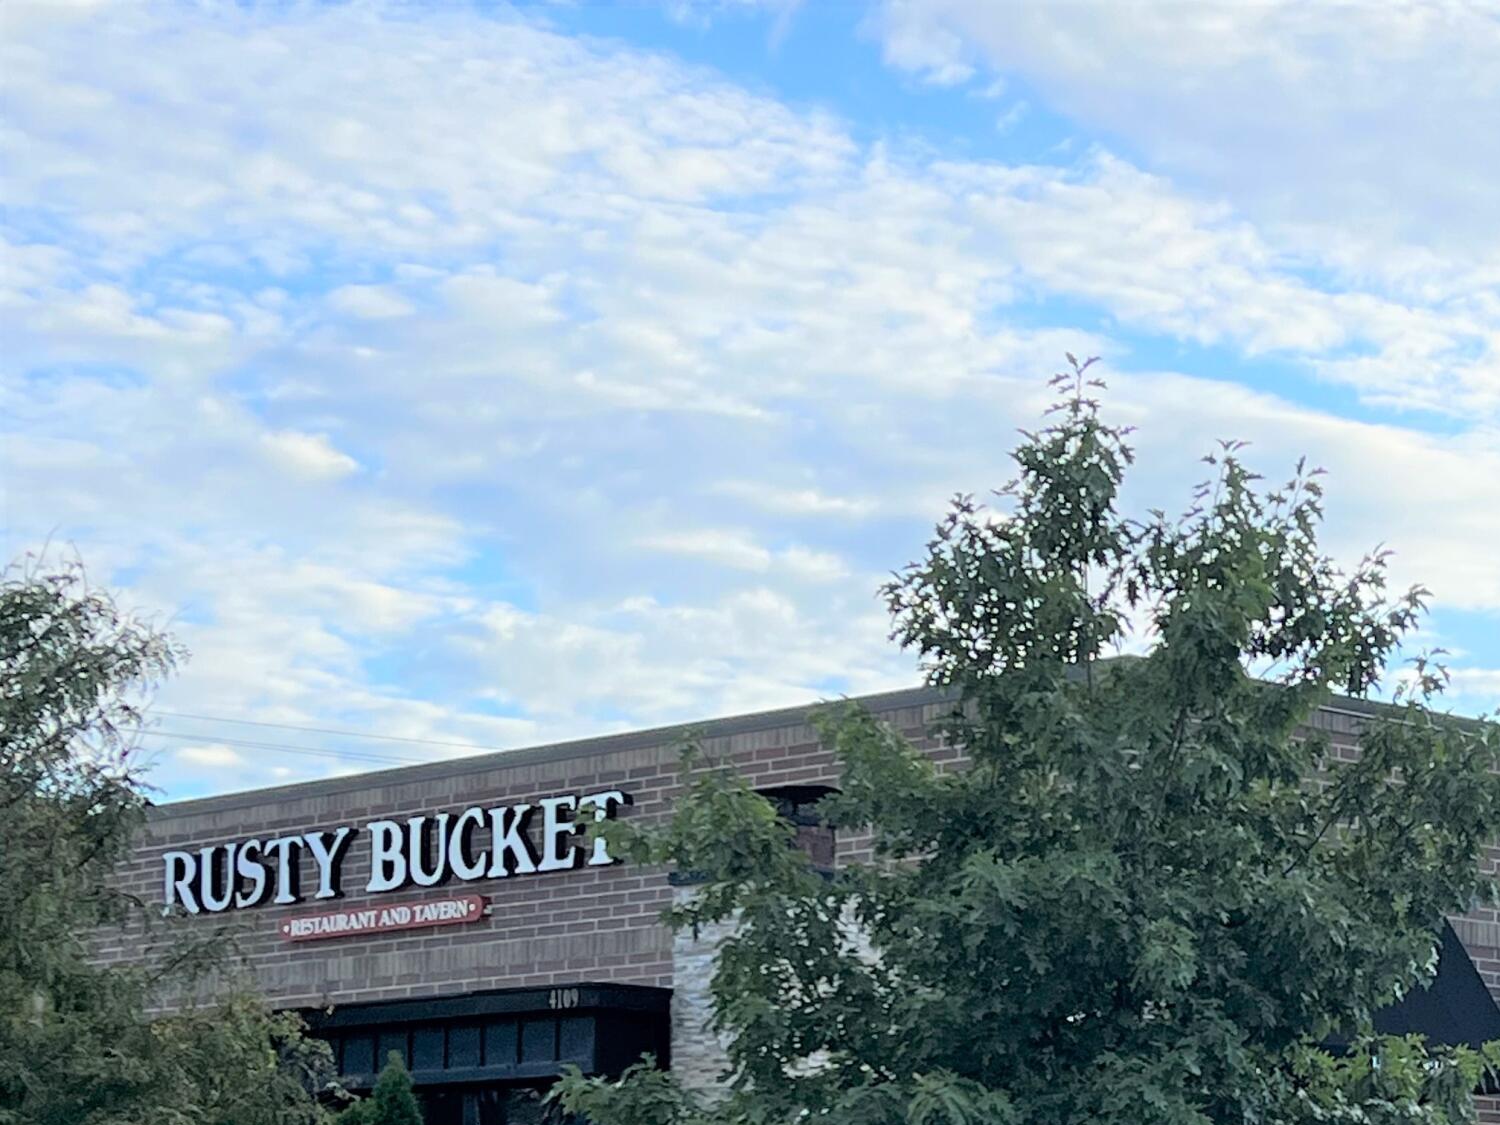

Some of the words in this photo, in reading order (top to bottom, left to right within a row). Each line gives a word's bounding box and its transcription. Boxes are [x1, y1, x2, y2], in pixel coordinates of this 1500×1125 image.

[162, 827, 353, 915] RUSTY
[365, 791, 625, 893] BUCKET
[290, 909, 378, 937] RESTAURANT
[378, 907, 411, 926] AND
[412, 899, 469, 922] TAVERN
